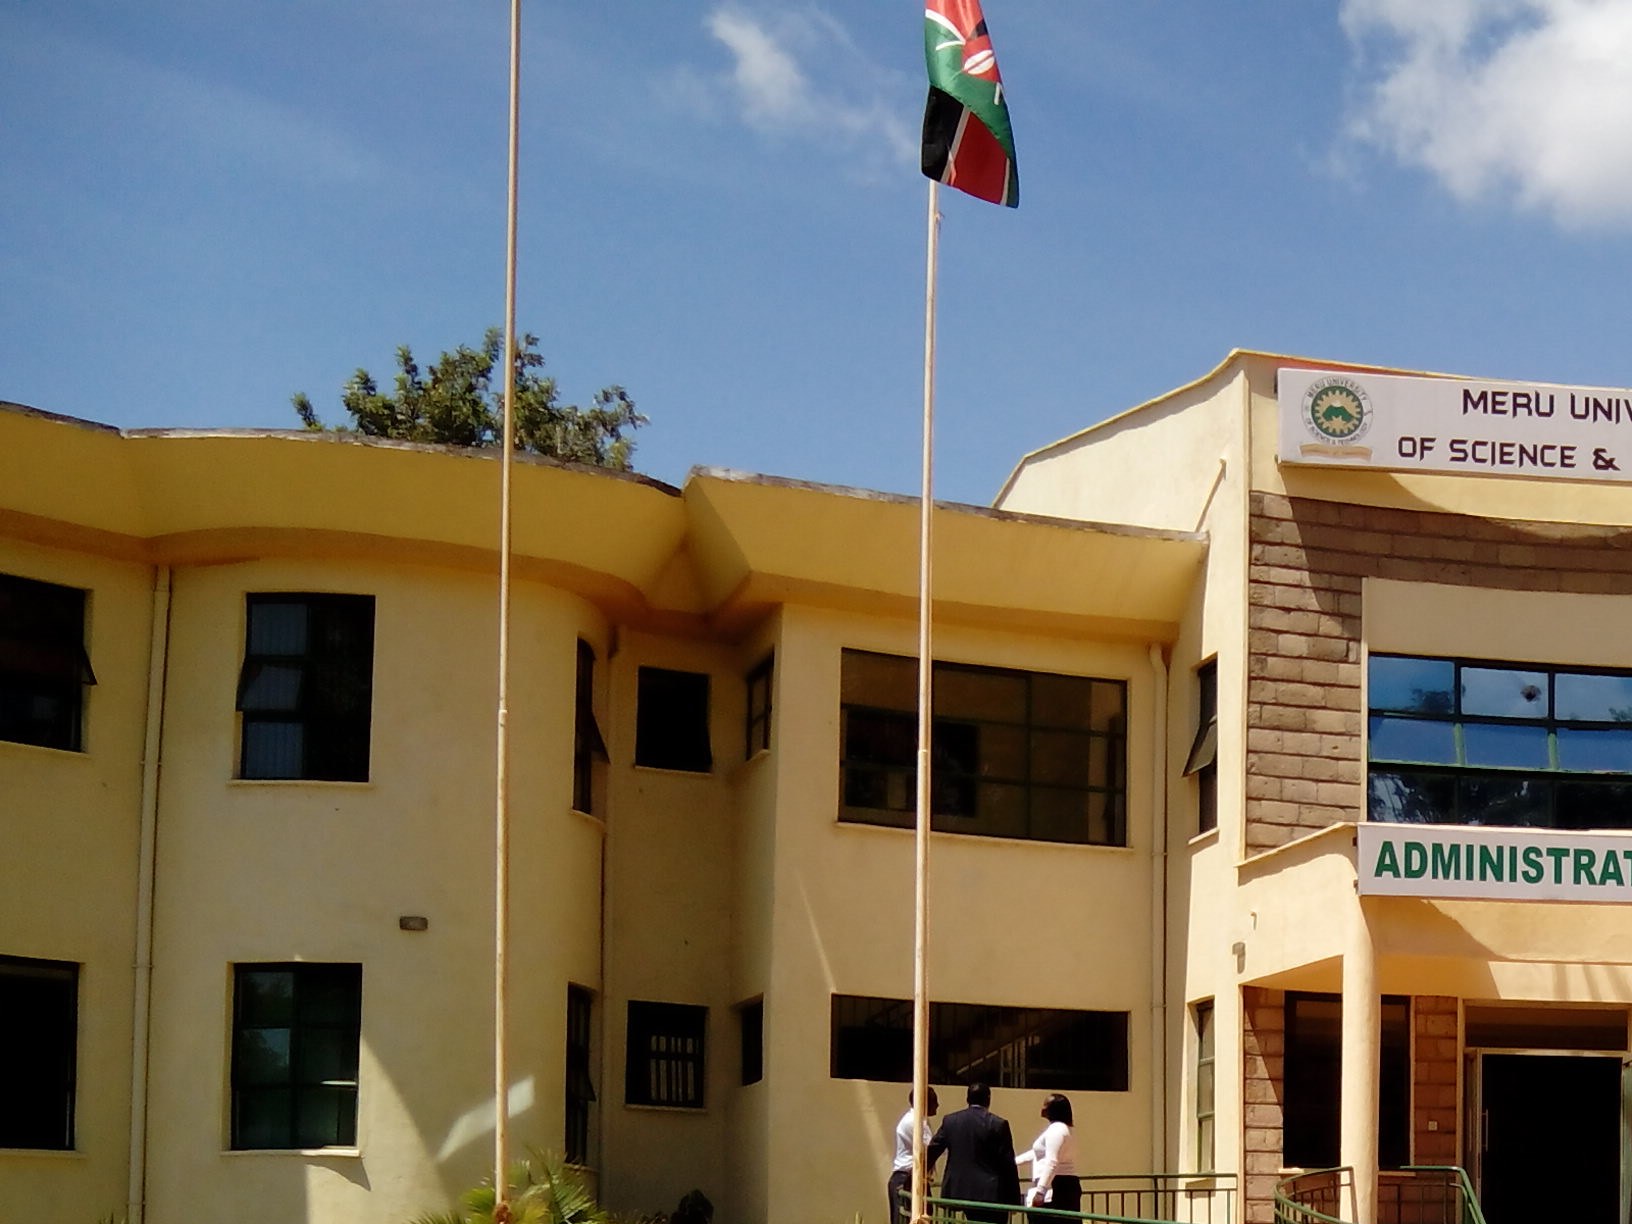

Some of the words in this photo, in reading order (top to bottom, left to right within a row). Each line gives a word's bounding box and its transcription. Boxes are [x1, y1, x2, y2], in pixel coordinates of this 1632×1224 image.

[1462, 388, 1555, 418] MERU
[1397, 436, 1436, 461] OF
[1449, 439, 1577, 468] SCIENCE
[1592, 448, 1620, 471] &
